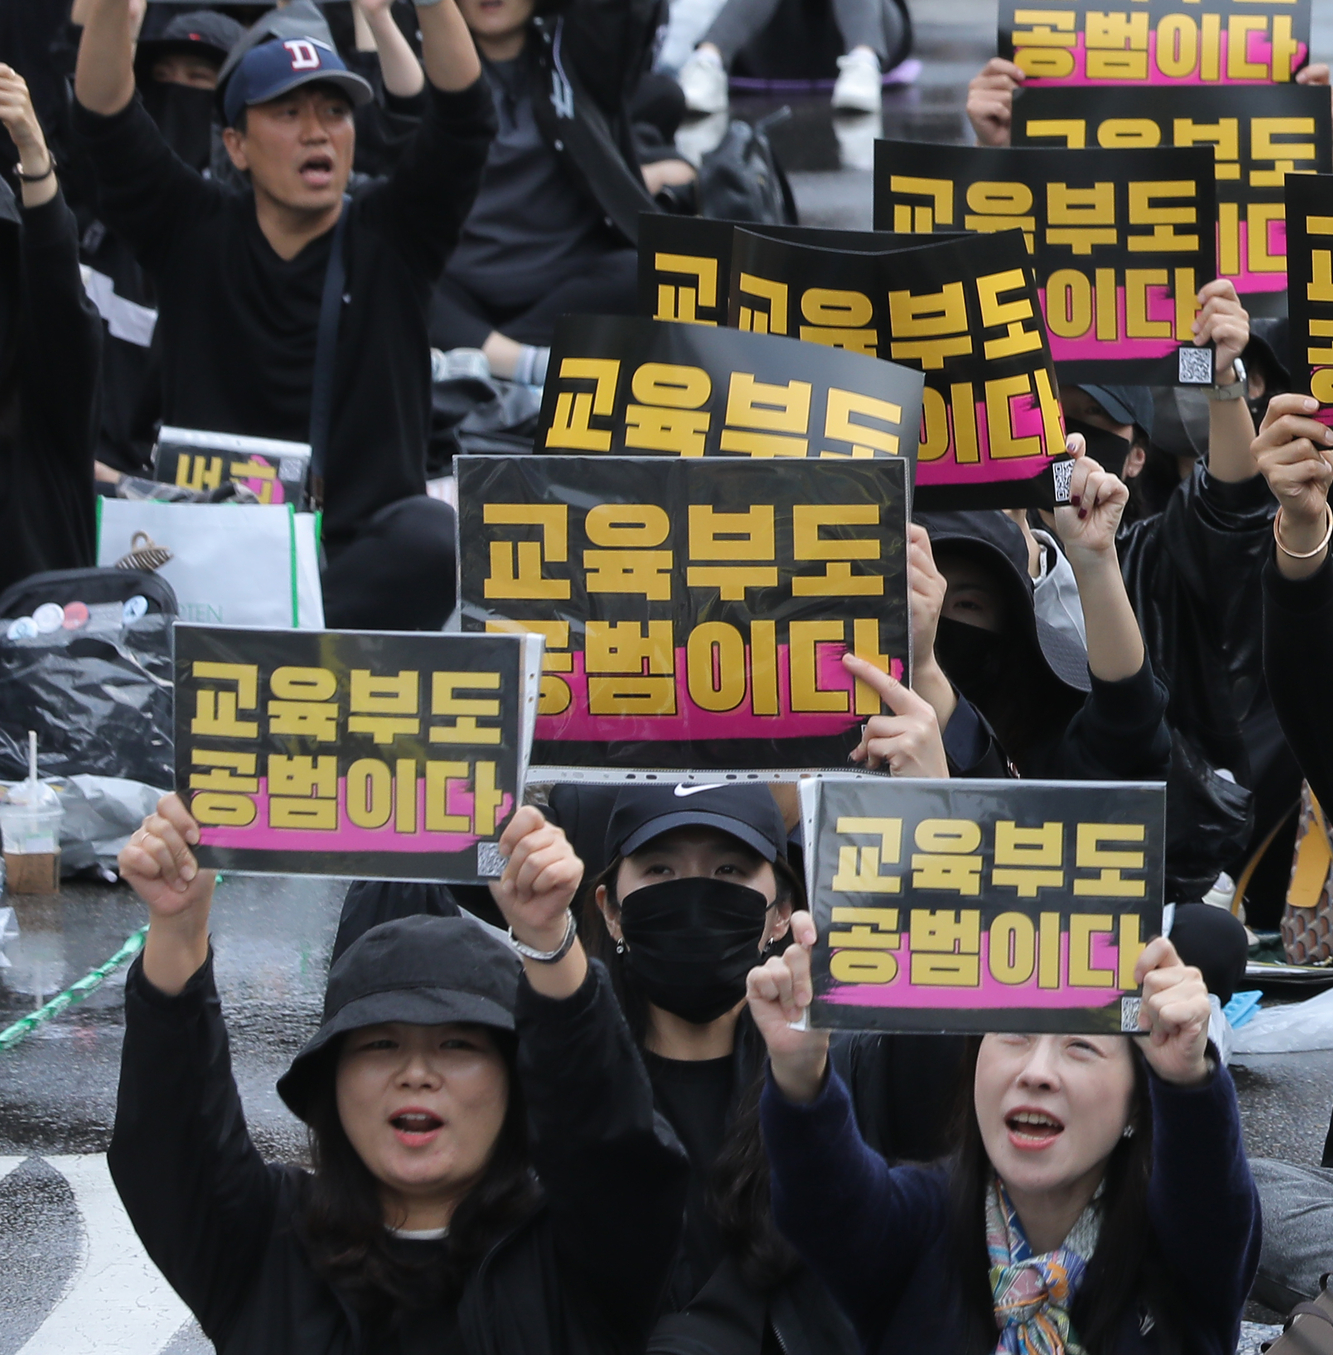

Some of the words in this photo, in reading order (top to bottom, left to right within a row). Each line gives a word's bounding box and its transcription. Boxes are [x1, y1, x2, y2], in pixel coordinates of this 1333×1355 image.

[283, 39, 322, 72] D
[1012, 9, 1301, 82] 공범이다
[890, 176, 1198, 253] 교육부도
[546, 357, 903, 458] 교육부도
[483, 503, 884, 601] 교육부도
[190, 662, 500, 747] 교육부도
[190, 752, 508, 834] 공범이다
[831, 817, 1145, 899] 교육부도
[829, 906, 1147, 991] 공범이다
